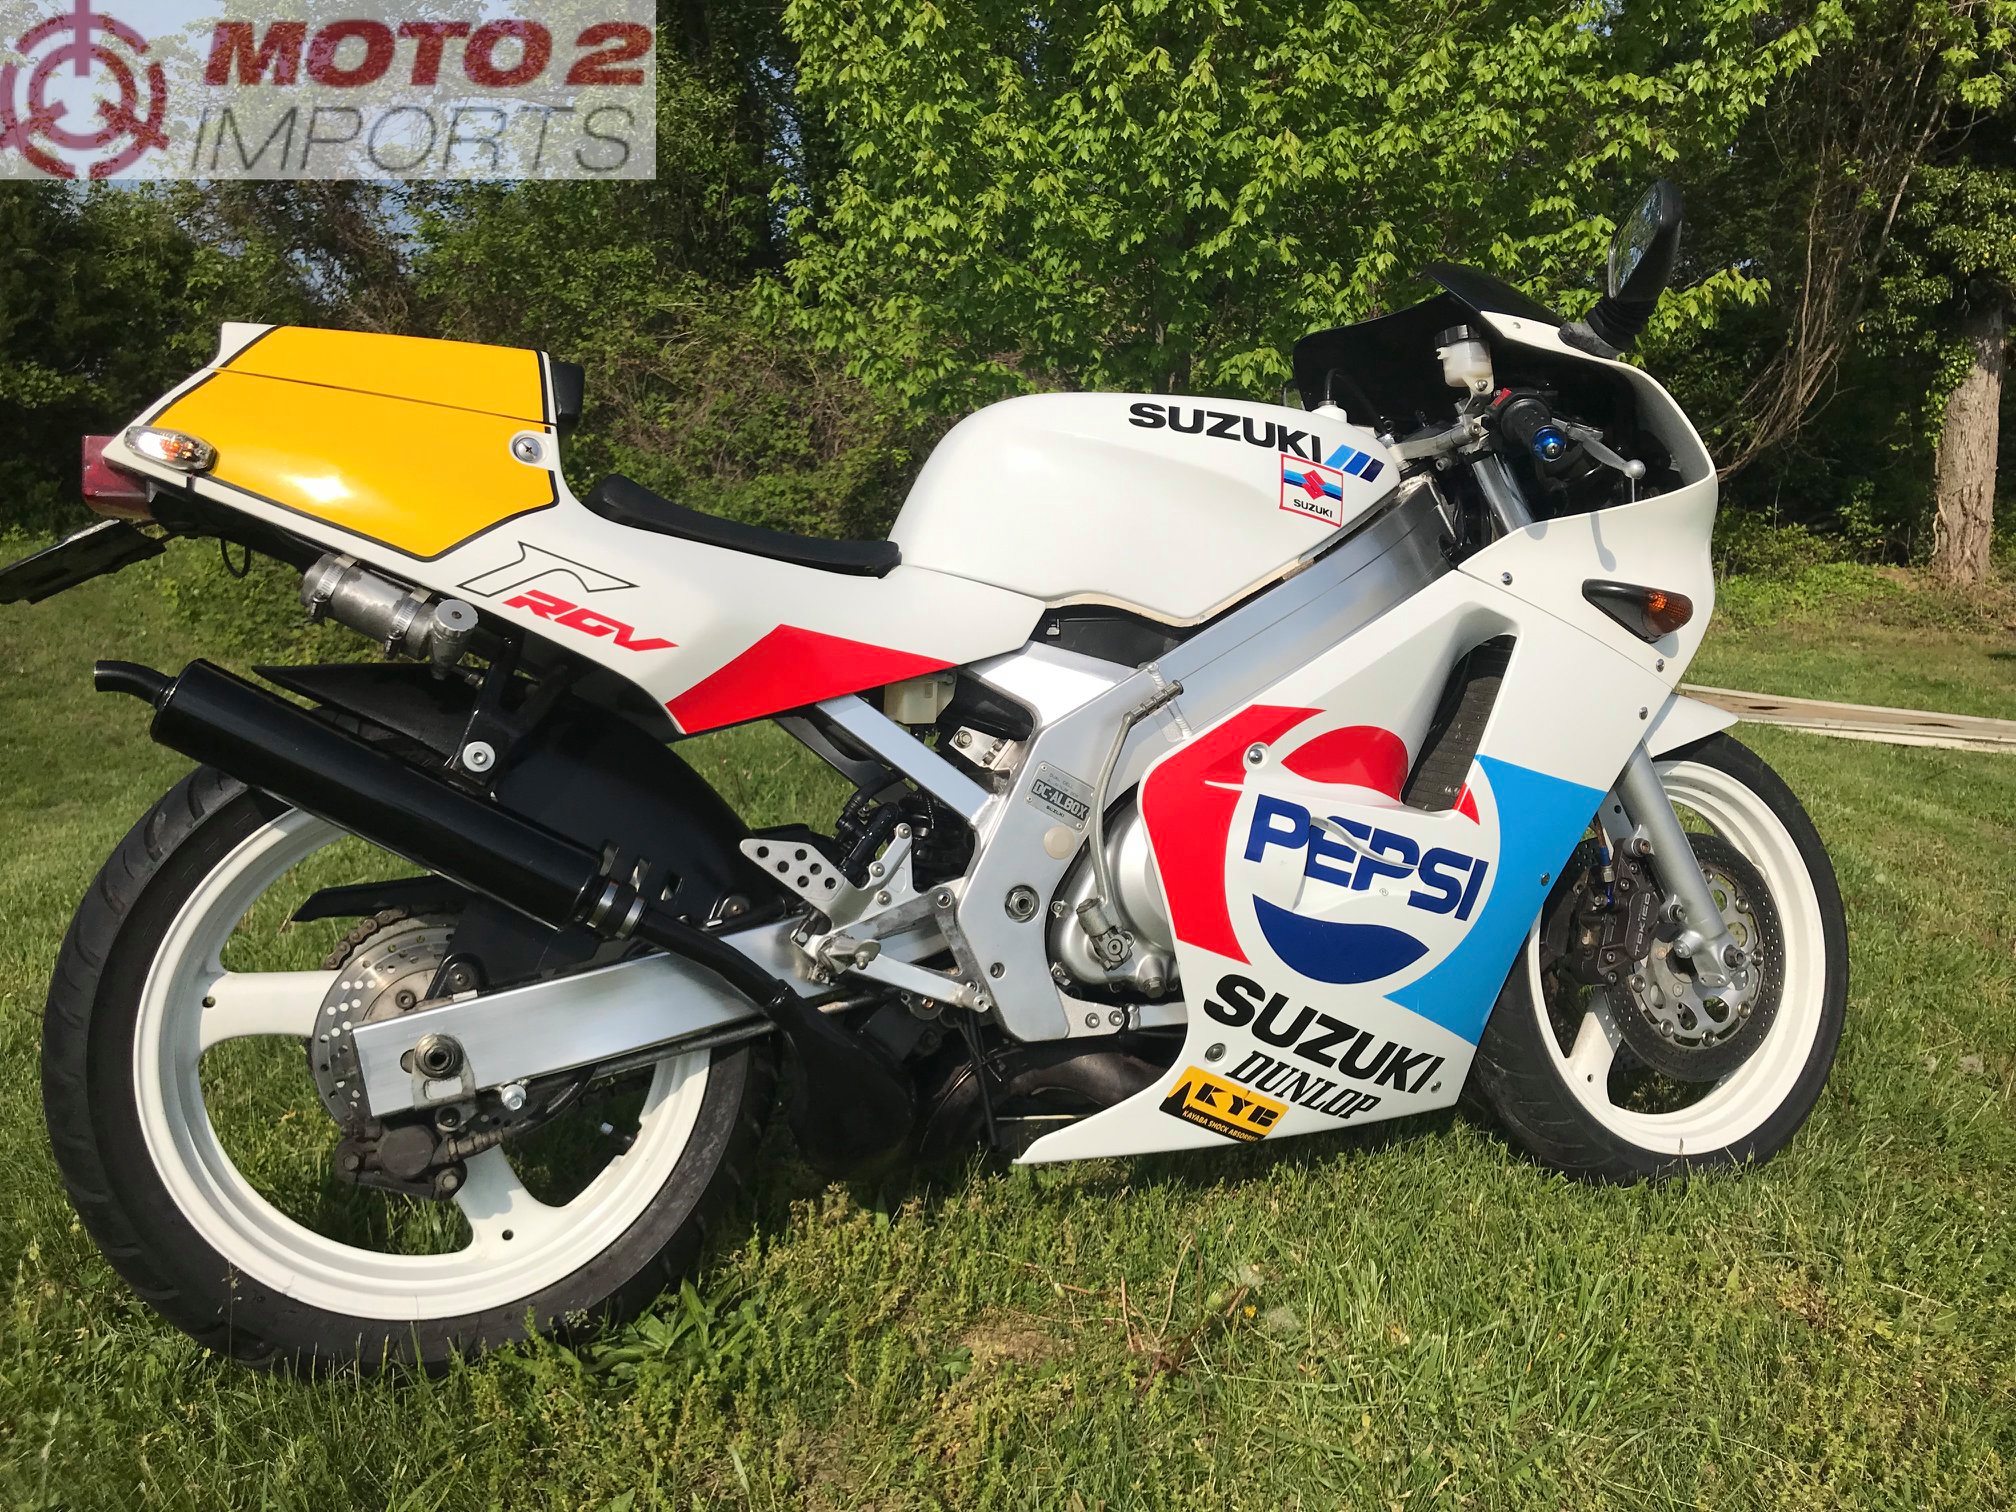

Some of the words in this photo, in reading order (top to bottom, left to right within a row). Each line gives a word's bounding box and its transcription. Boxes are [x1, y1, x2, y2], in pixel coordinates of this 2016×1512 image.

[1128, 402, 1322, 464] SUZUKI
[1293, 498, 1333, 518] SUZUKI
[501, 589, 680, 651] RGV
[1244, 793, 1489, 922] PEPSI
[1203, 974, 1445, 1094] SUZUKI
[1195, 1082, 1279, 1127] KYB
[1225, 1050, 1382, 1120] DUNLOP
[1207, 1119, 1229, 1134] SHOCK
